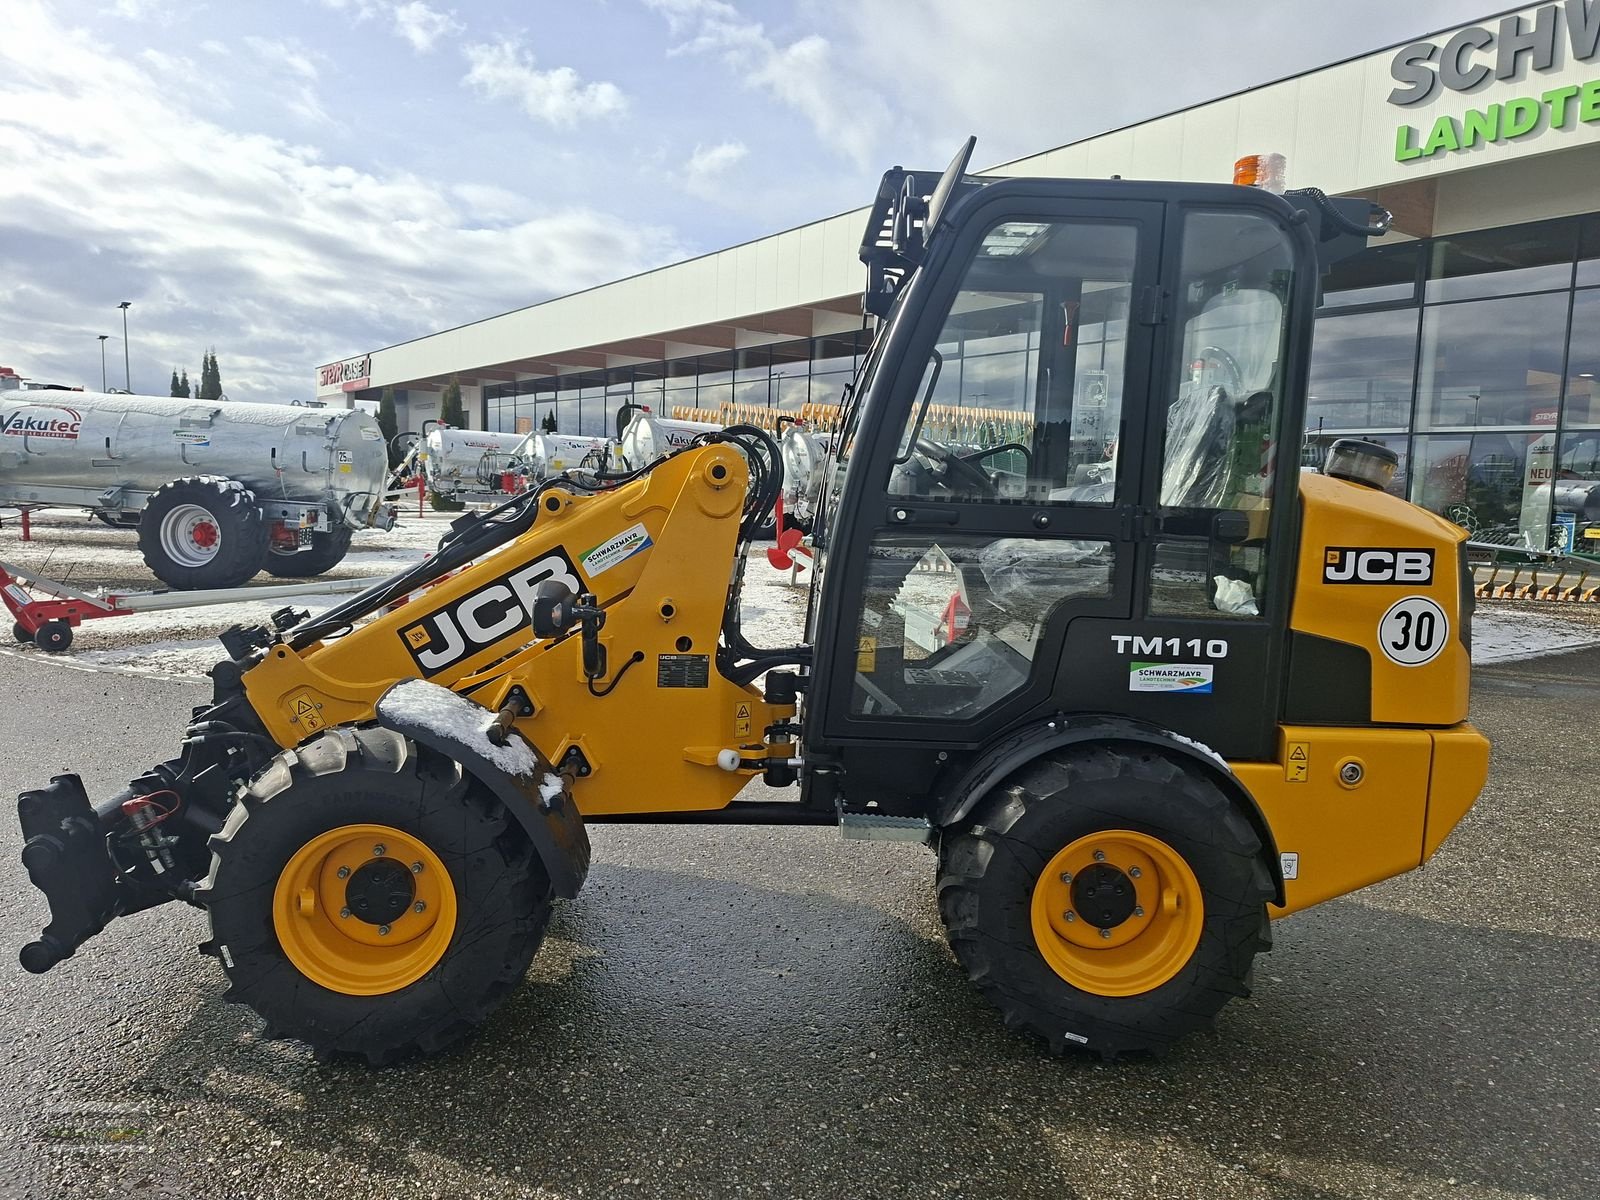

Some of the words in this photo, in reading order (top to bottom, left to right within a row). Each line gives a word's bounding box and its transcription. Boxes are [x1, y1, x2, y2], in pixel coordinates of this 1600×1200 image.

[1395, 80, 1600, 162] LANDTE
[320, 362, 343, 386] STEYR
[0, 411, 80, 433] Vakutec
[339, 451, 347, 462] 25
[588, 532, 638, 562] SCHWARZMAYR
[1326, 551, 1431, 581] JCB
[417, 556, 580, 669] JCB
[1391, 610, 1436, 651] 30
[1111, 635, 1228, 658] TM110
[1139, 669, 1202, 677] SCHWARZMAYR
